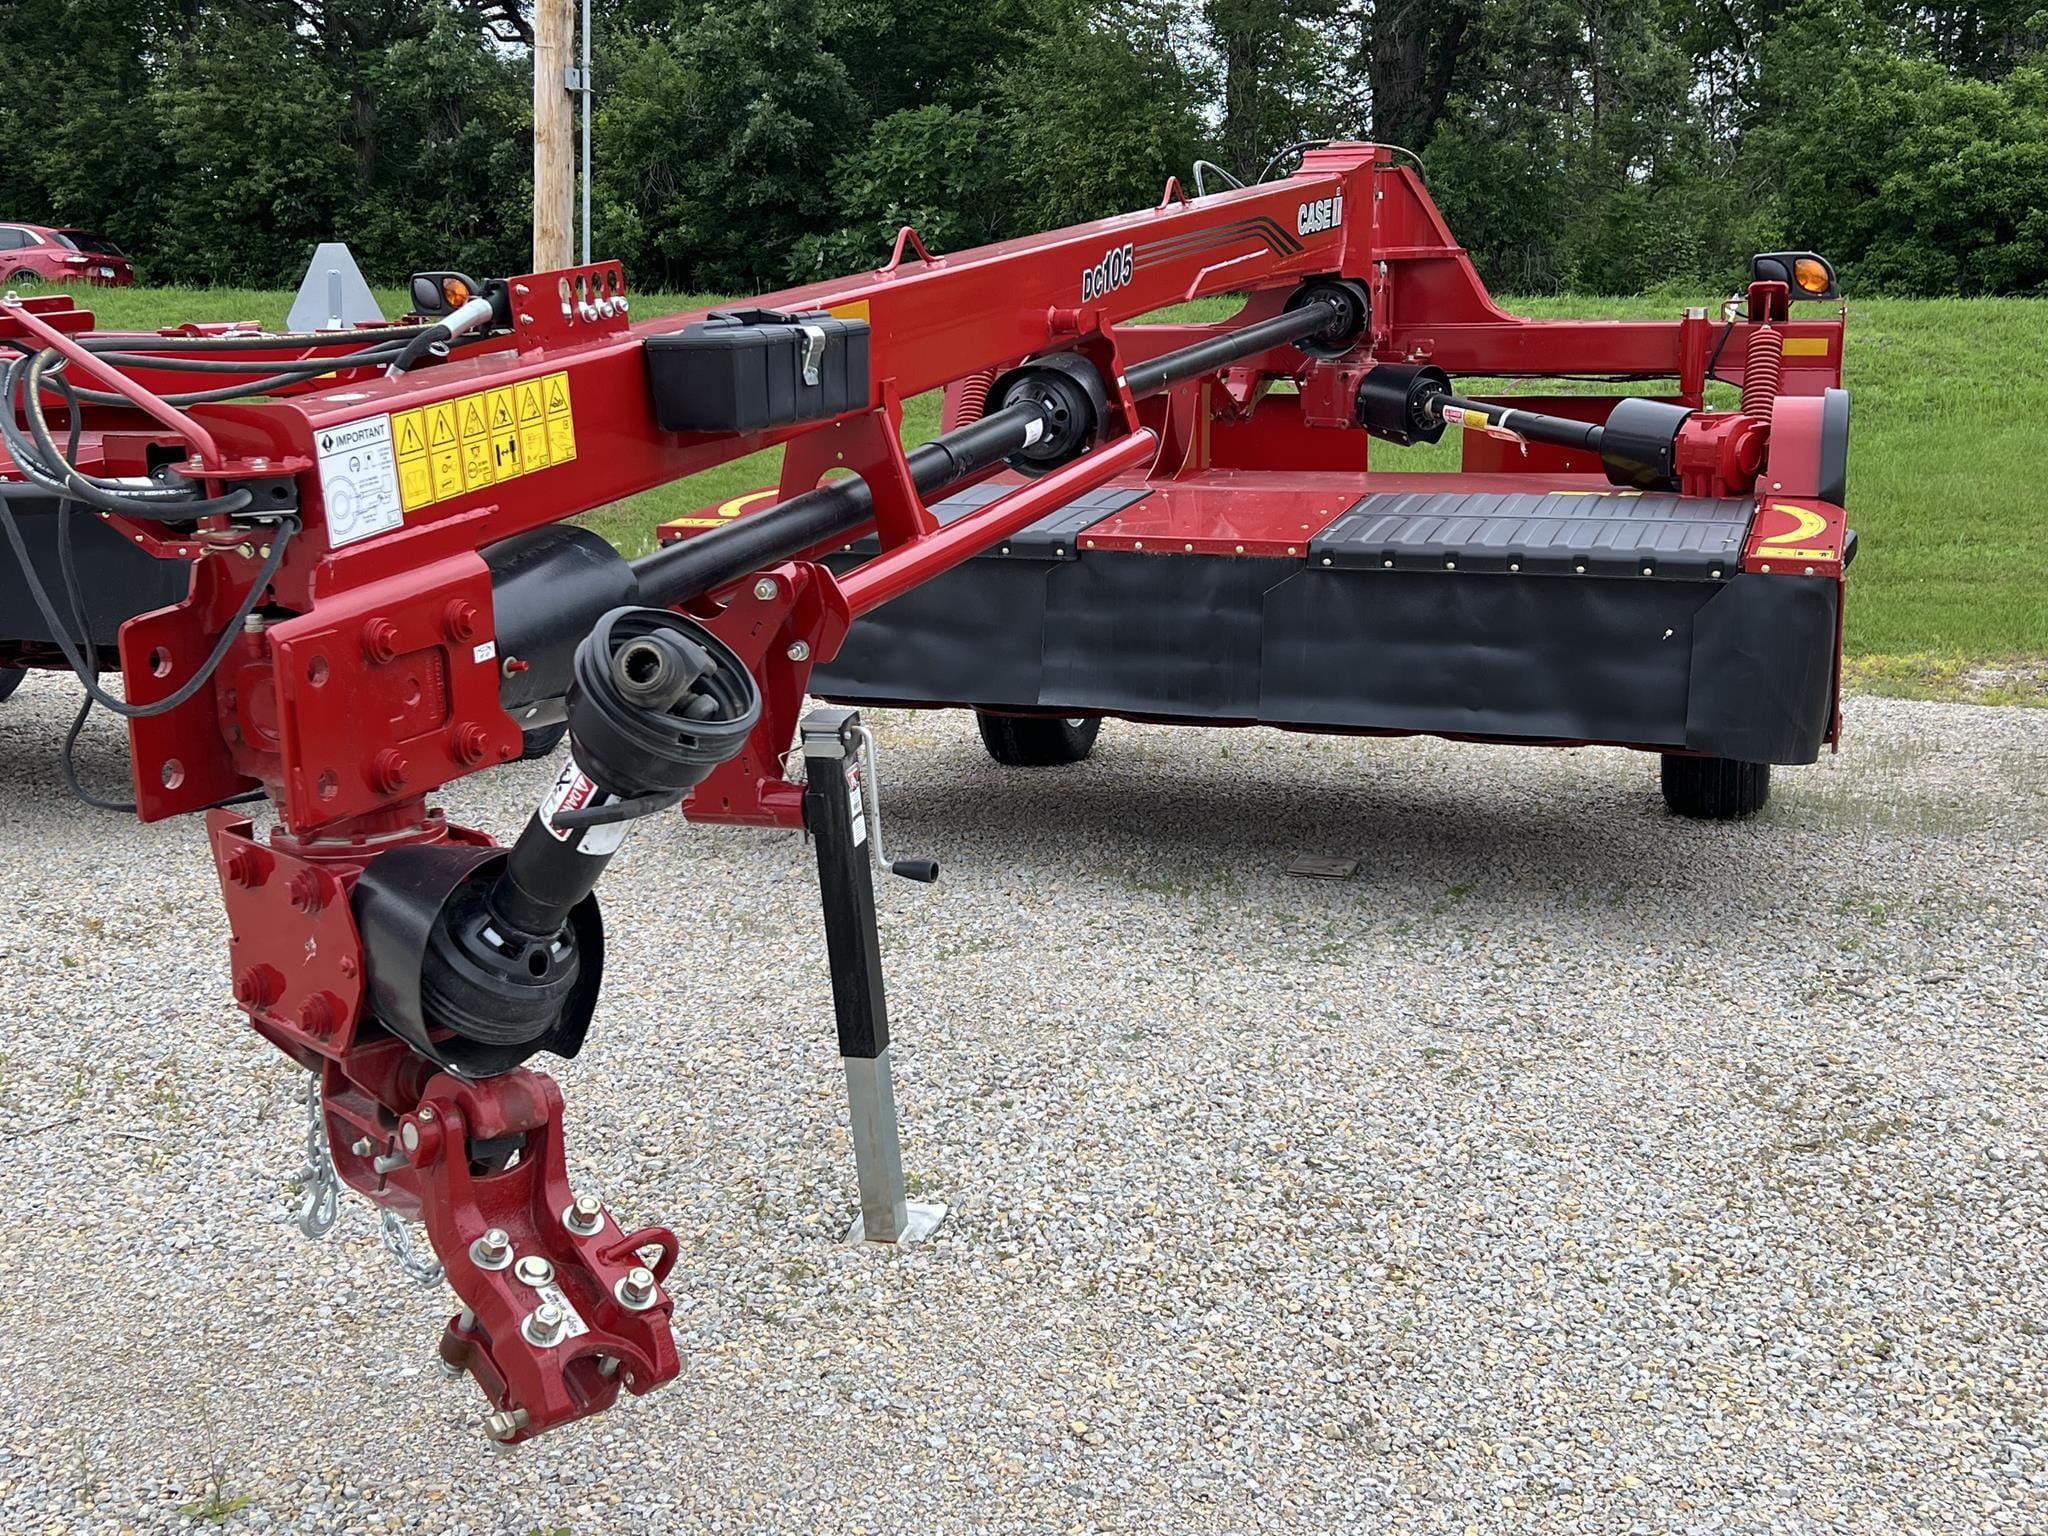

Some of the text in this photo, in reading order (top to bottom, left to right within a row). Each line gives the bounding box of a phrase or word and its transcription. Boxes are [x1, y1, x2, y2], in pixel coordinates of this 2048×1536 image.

[1297, 198, 1332, 236] CASE
[1082, 242, 1134, 304] DC105
[335, 424, 385, 448] IMPORTANT
